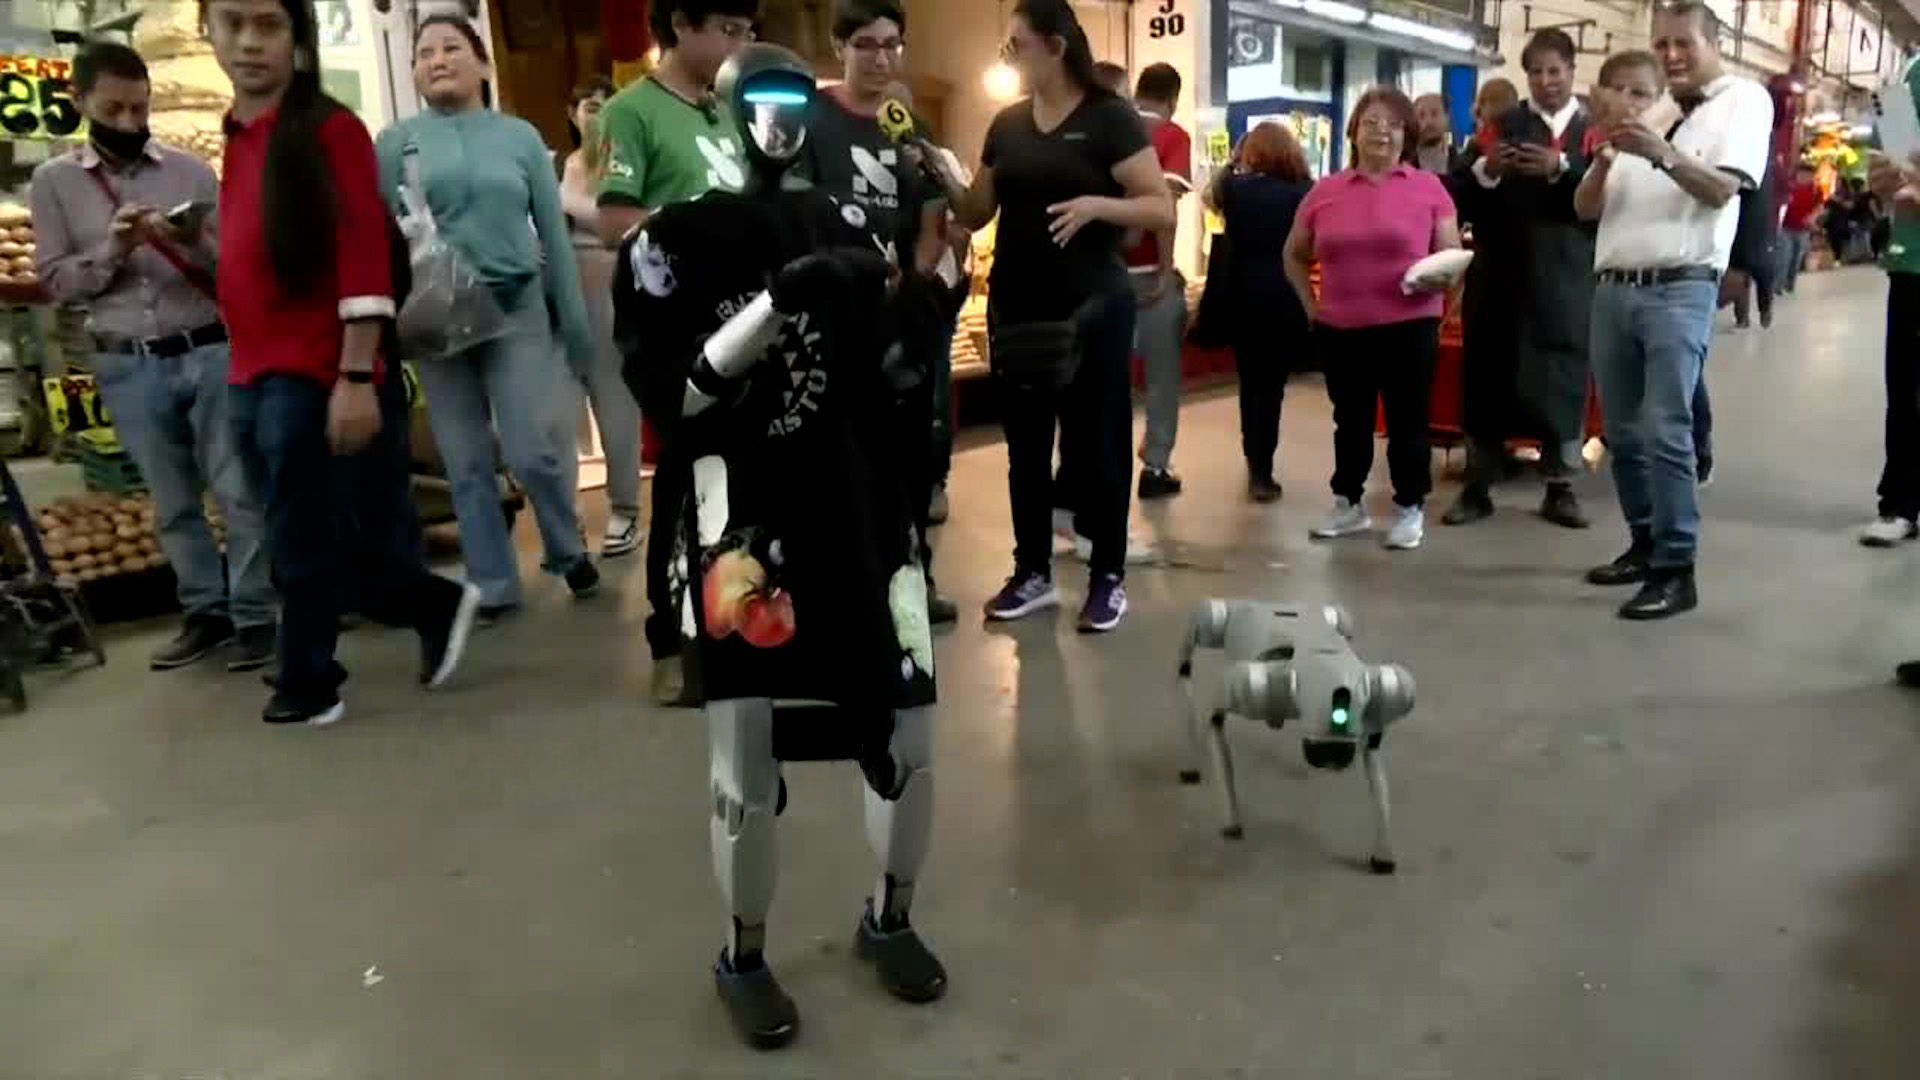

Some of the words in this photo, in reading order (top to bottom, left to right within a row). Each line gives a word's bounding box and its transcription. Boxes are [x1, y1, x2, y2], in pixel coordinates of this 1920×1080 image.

[1149, 13, 1185, 38] 90
[0, 73, 81, 135] 25
[887, 103, 904, 124] 6
